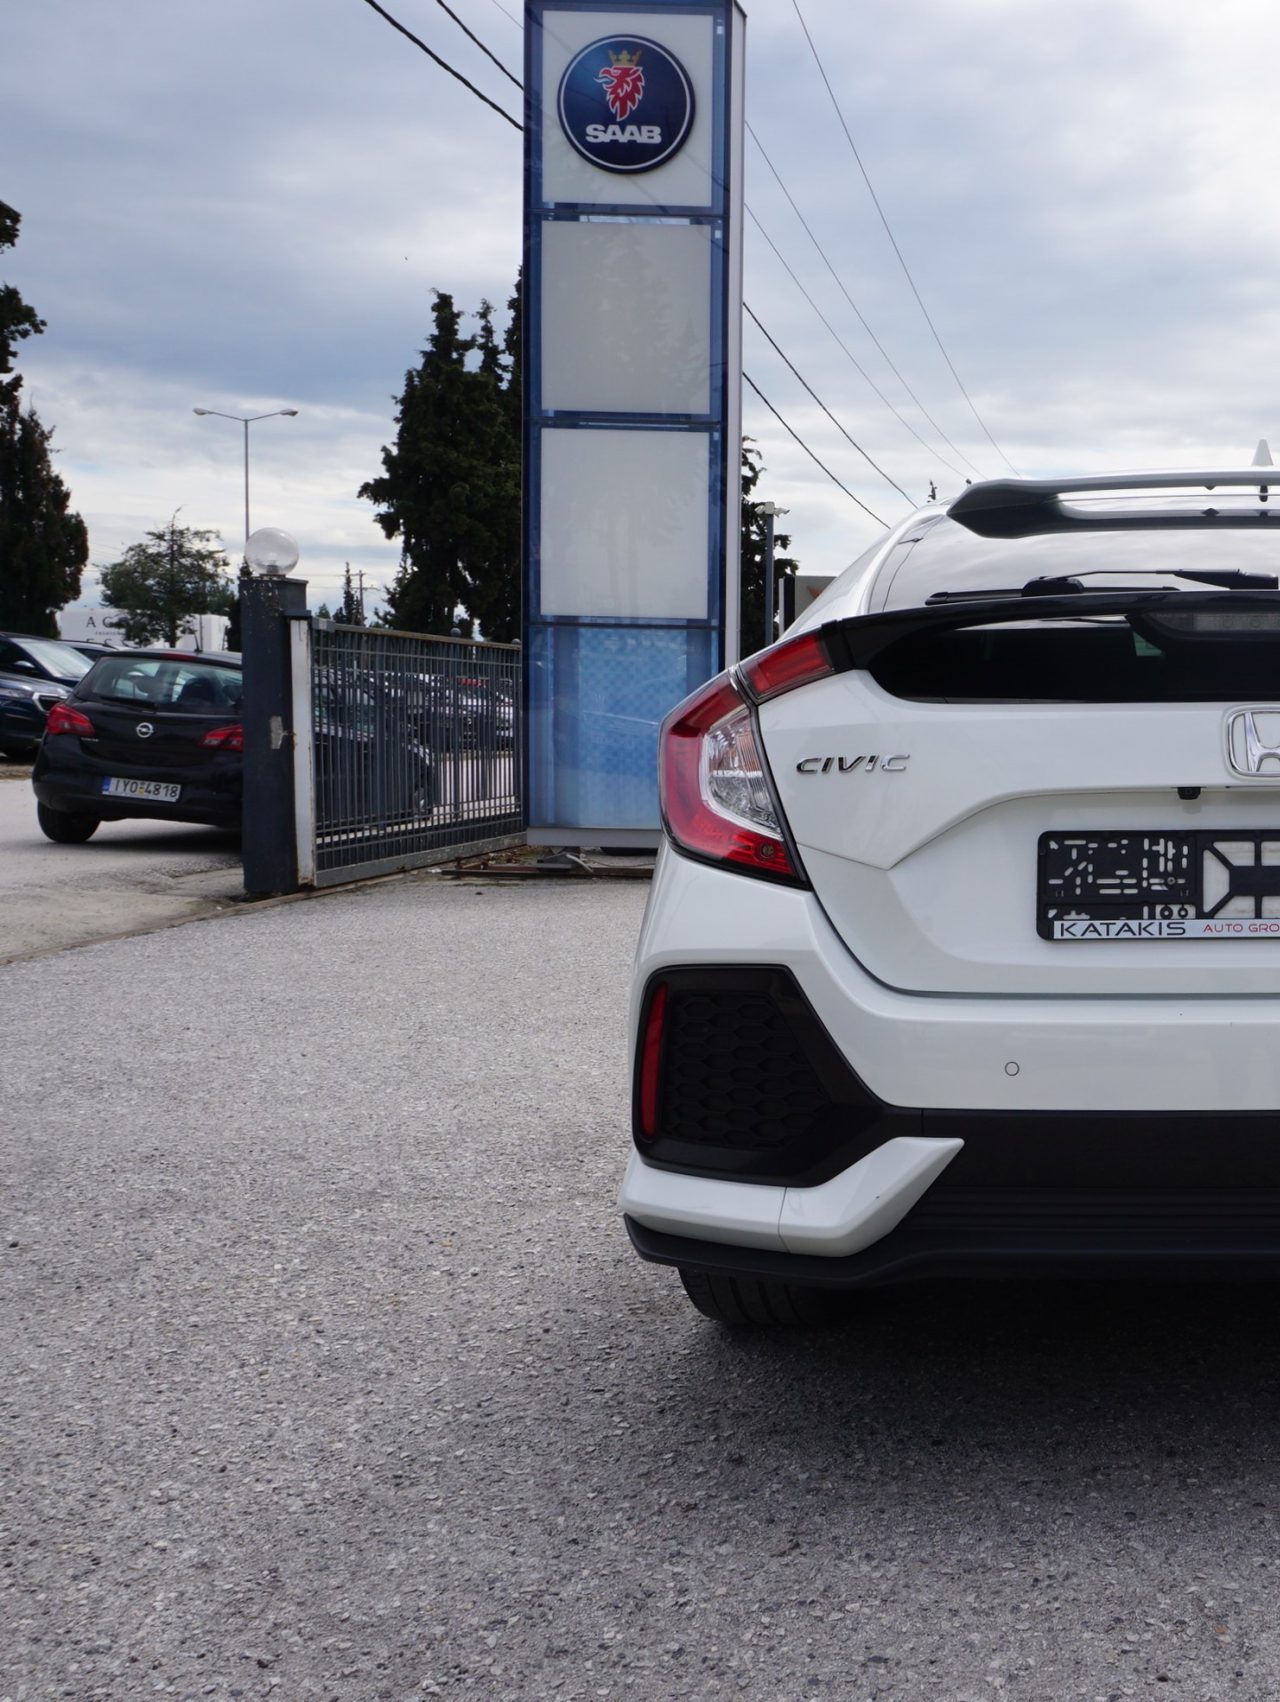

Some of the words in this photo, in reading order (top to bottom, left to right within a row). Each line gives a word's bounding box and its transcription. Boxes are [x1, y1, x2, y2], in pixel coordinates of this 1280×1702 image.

[585, 124, 662, 144] SAAB
[796, 754, 911, 774] CIVIC
[1060, 922, 1186, 937] KATAKIS
[1203, 923, 1244, 933] AUTO
